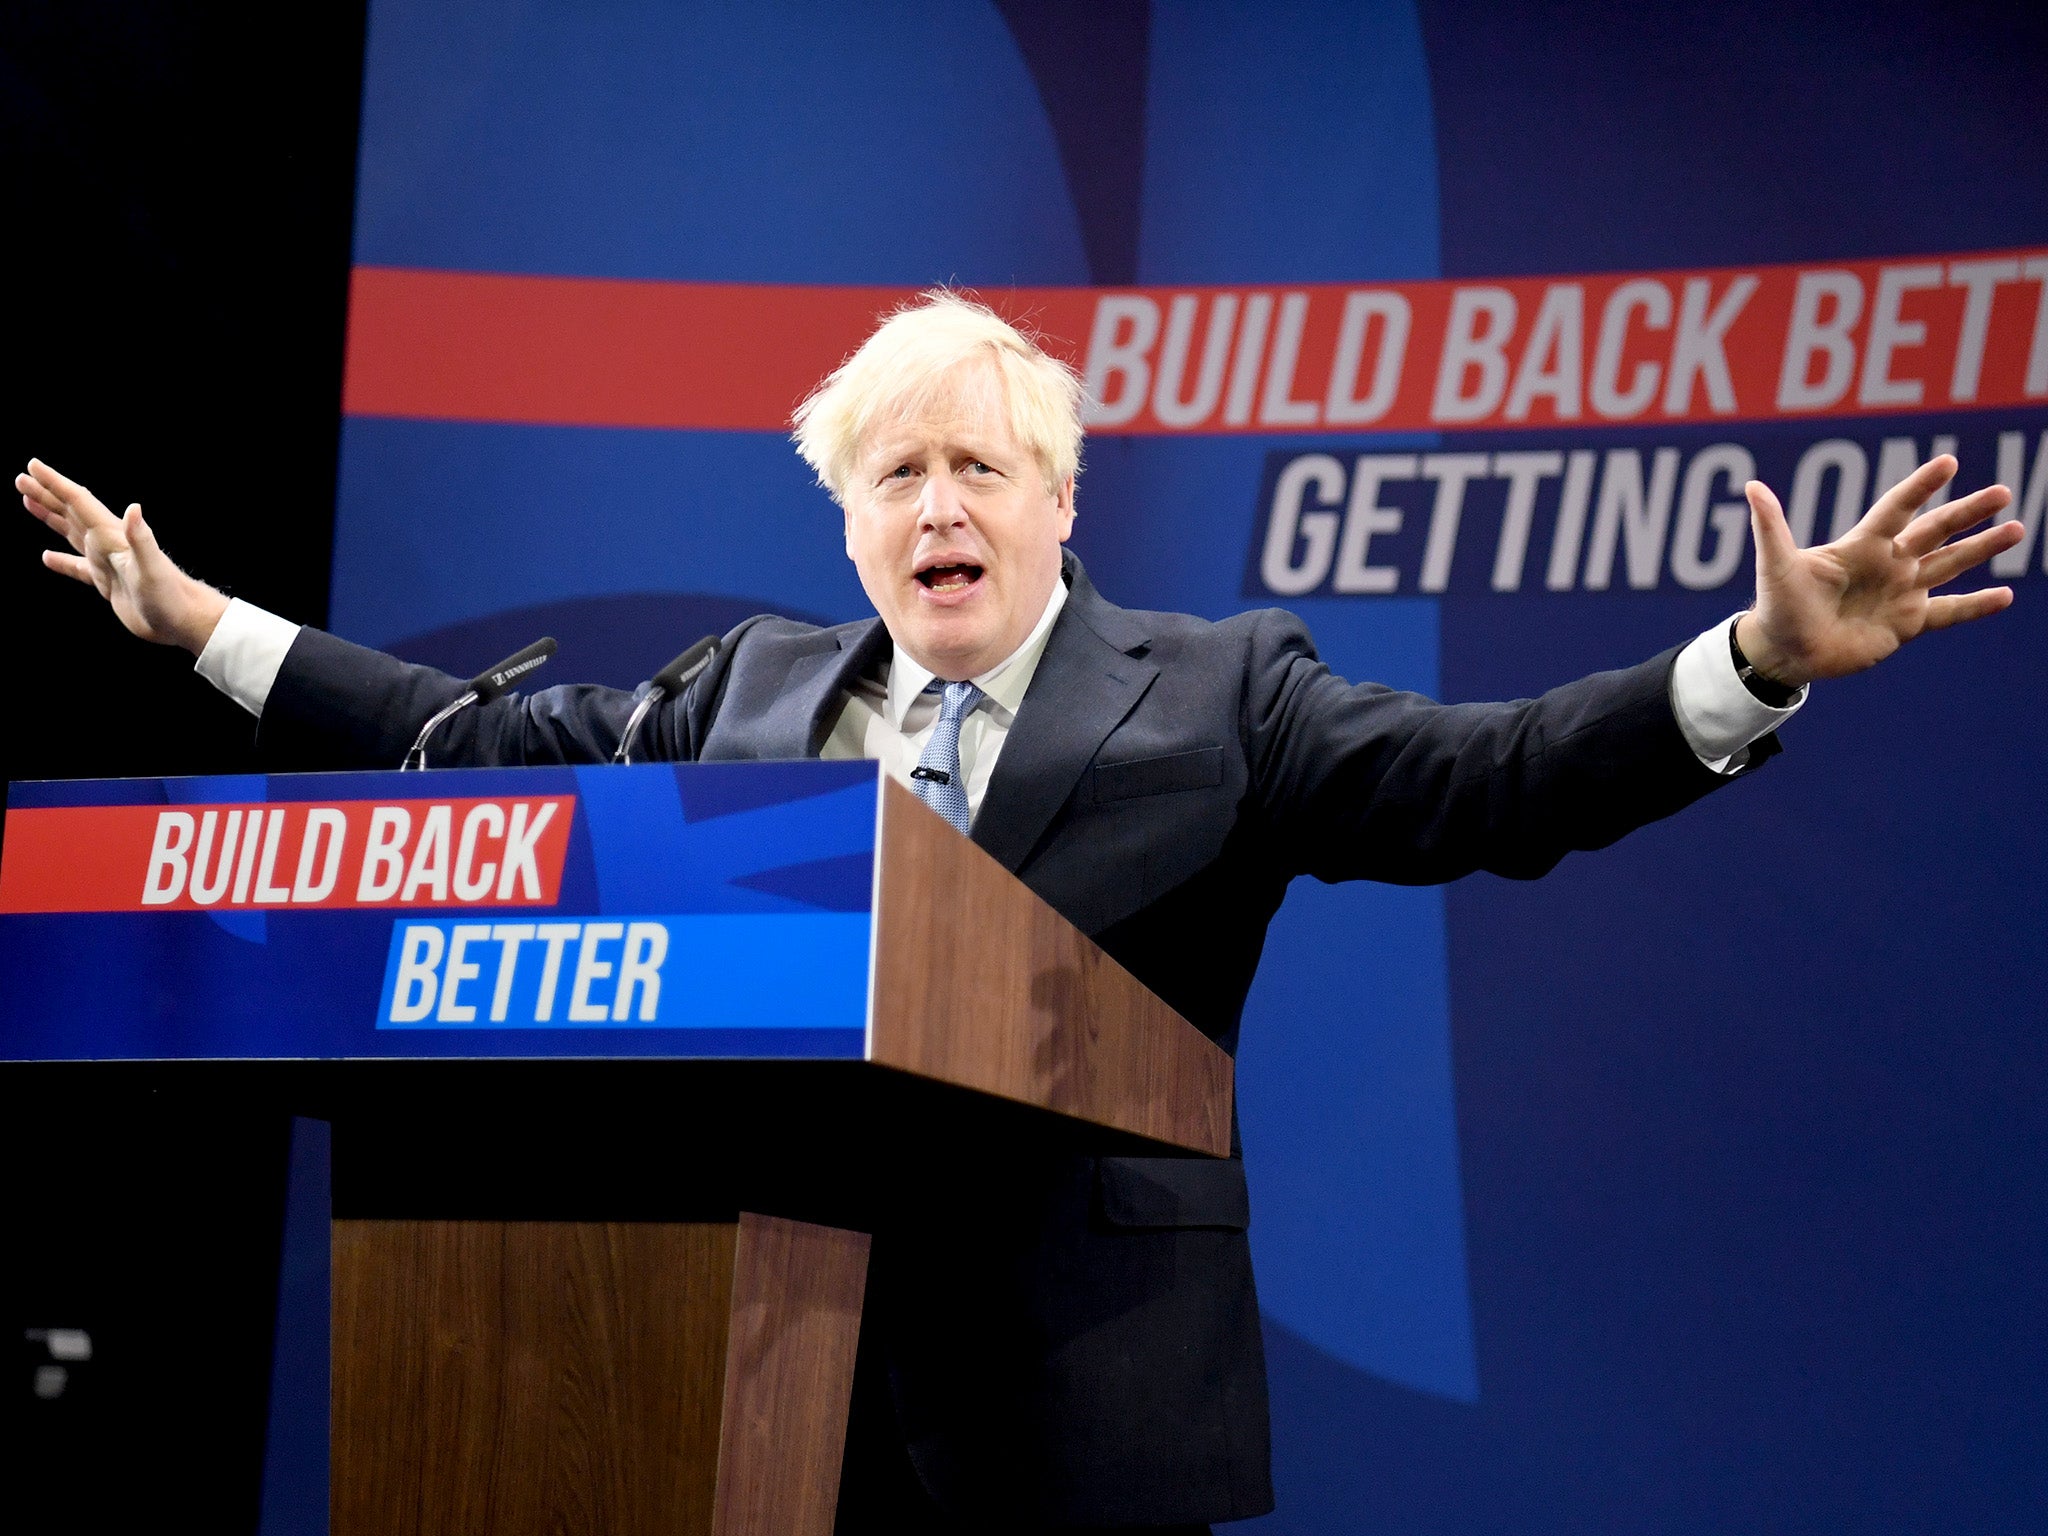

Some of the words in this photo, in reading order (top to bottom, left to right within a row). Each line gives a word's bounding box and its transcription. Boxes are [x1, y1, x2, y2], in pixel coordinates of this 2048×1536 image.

[1083, 293, 1411, 428] BUILD
[1431, 279, 1757, 422] BACK
[1263, 446, 1758, 594] GETTING
[141, 807, 347, 905] BUILD
[356, 802, 559, 902] BACK
[390, 922, 669, 1022] BETTER
